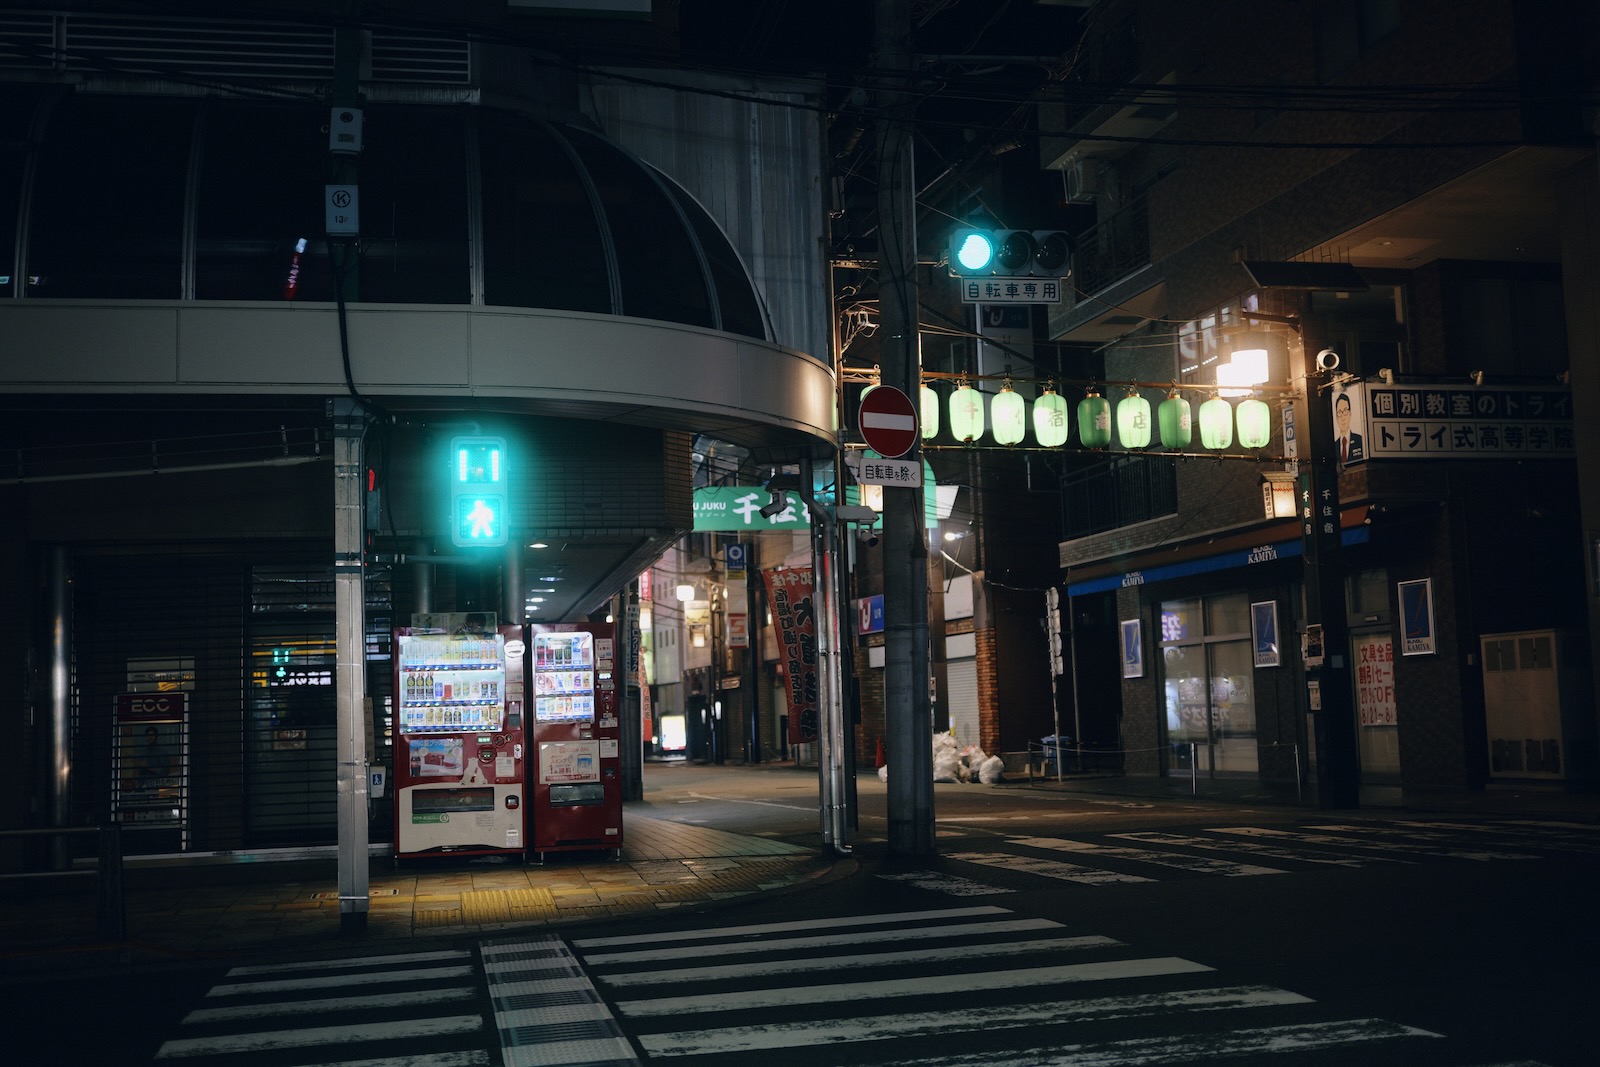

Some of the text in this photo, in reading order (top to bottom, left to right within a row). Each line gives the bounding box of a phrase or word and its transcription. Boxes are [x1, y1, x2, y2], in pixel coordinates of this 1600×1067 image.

[968, 281, 1057, 299] 自転車専用
[1374, 393, 1569, 416] 個別教室のトライ
[1381, 426, 1573, 449] トライ式高等学院
[865, 464, 916, 481] 自転車を除く
[701, 502, 726, 511] JUKU
[1322, 488, 1334, 534] 千住宿
[1247, 549, 1278, 565] KAMIYA
[1121, 575, 1145, 588] KAMIYA
[1361, 643, 1393, 663] 文具全品
[1407, 644, 1431, 652] KAMIYA
[131, 698, 171, 713] ECC
